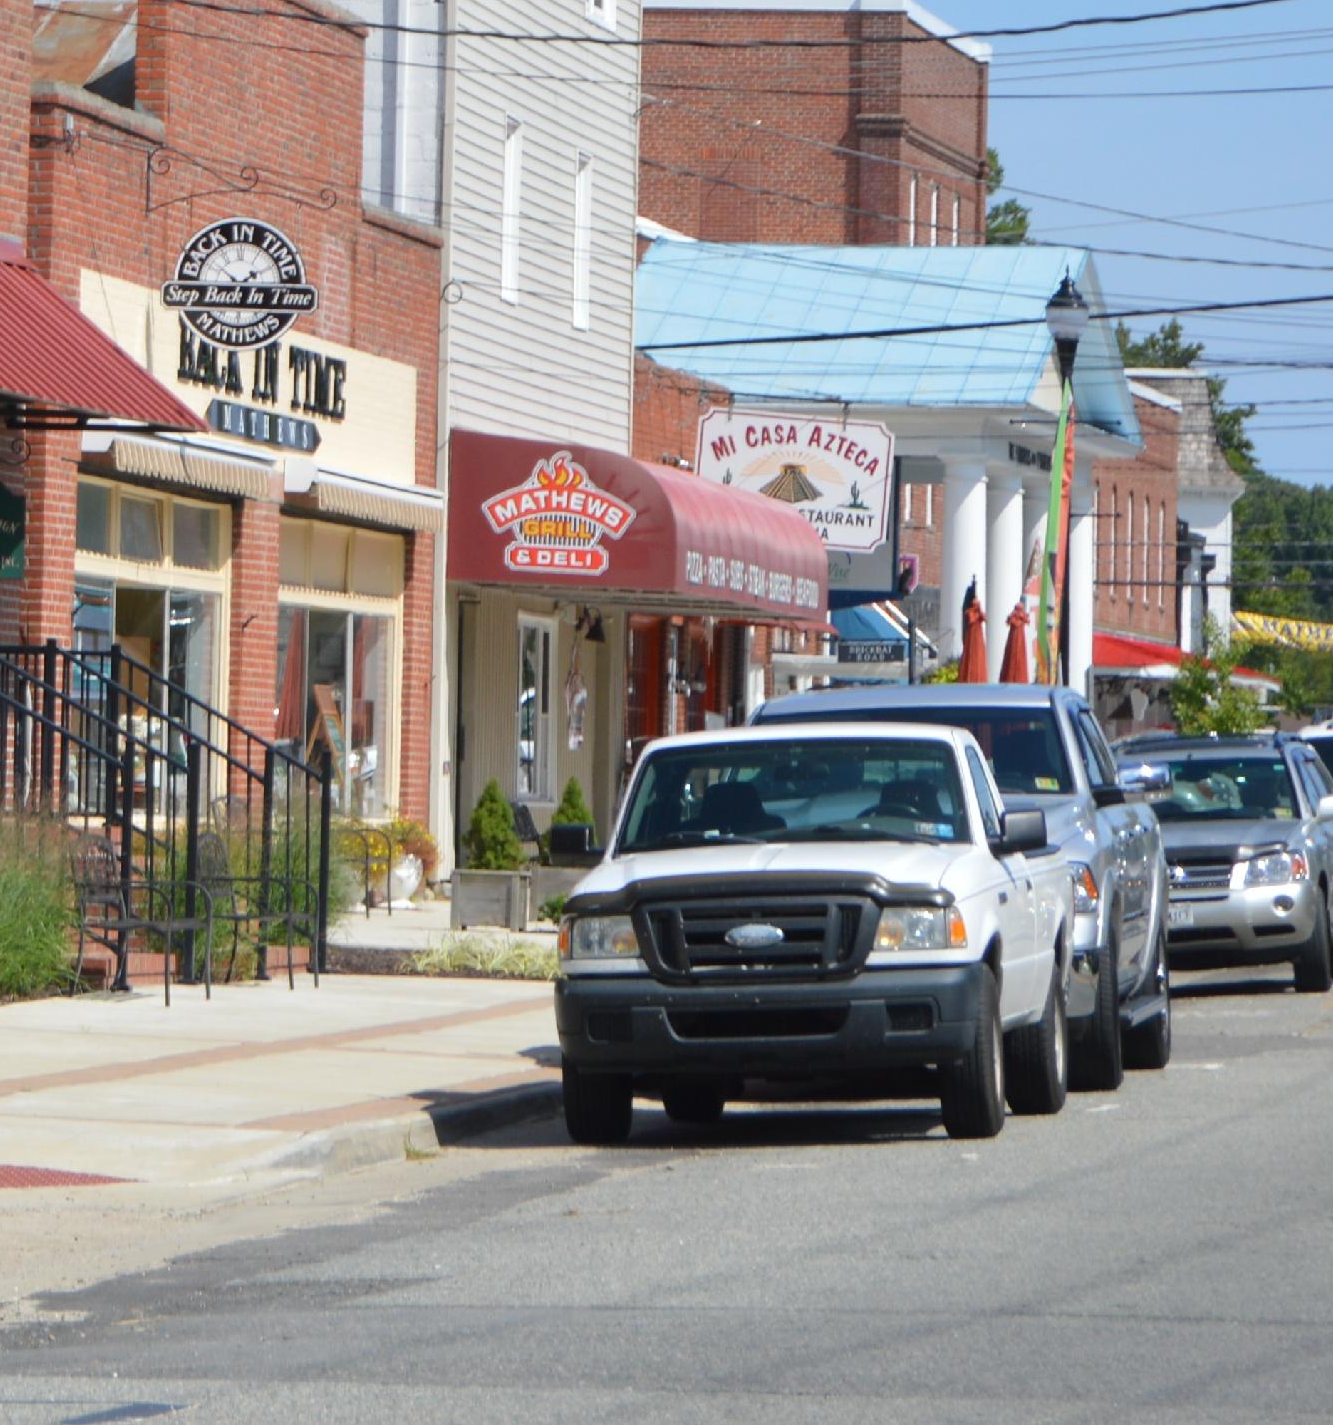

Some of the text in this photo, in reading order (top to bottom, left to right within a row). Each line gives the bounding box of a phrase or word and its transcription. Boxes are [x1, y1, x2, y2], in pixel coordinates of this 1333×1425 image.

[183, 224, 296, 280] BACK IN TIME
[166, 285, 312, 306] Step Back In Time
[196, 312, 280, 343] MATHEWS
[288, 345, 347, 420] TIME
[223, 404, 309, 449] MATHEWS
[711, 425, 880, 476] MI CASA AZTECA
[494, 490, 624, 528] MATHEWS
[524, 520, 592, 539] GRILL
[516, 549, 592, 567] & DELI
